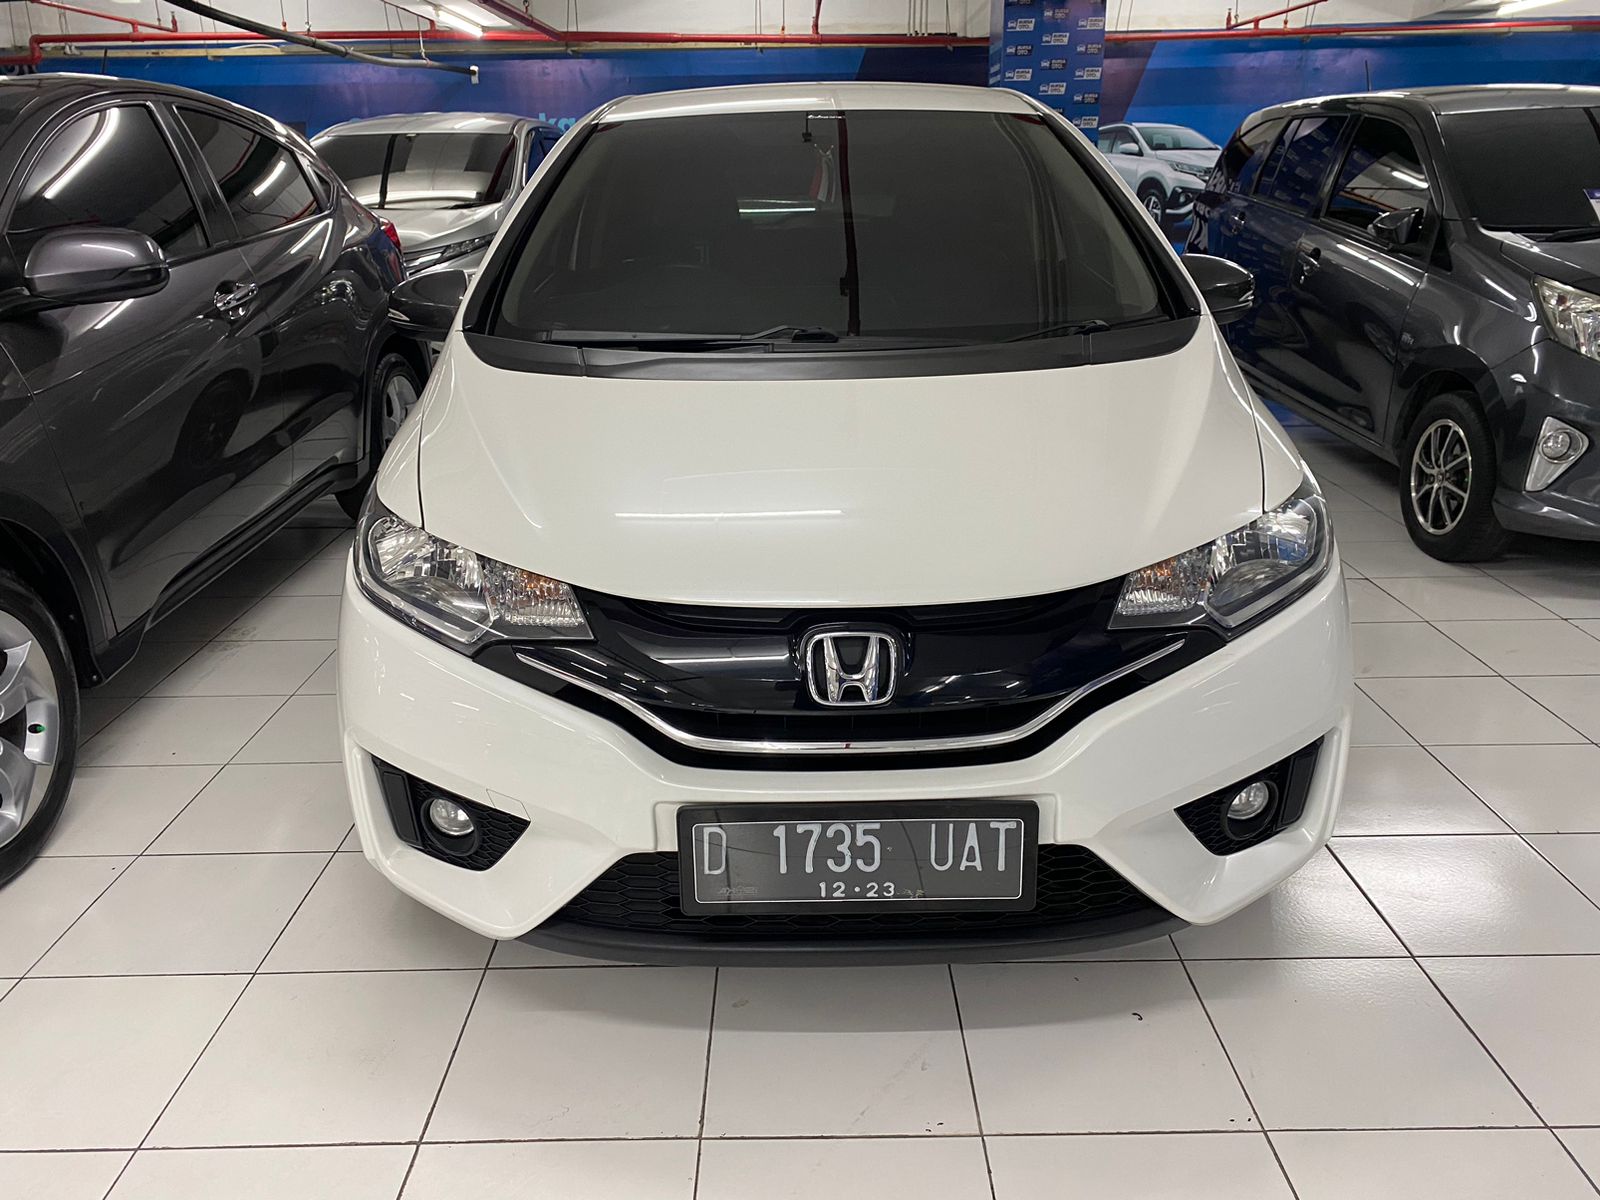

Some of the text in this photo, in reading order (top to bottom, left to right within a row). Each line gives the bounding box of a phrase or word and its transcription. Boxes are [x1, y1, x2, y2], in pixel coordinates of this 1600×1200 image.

[703, 820, 1018, 876] D 1735 UAT
